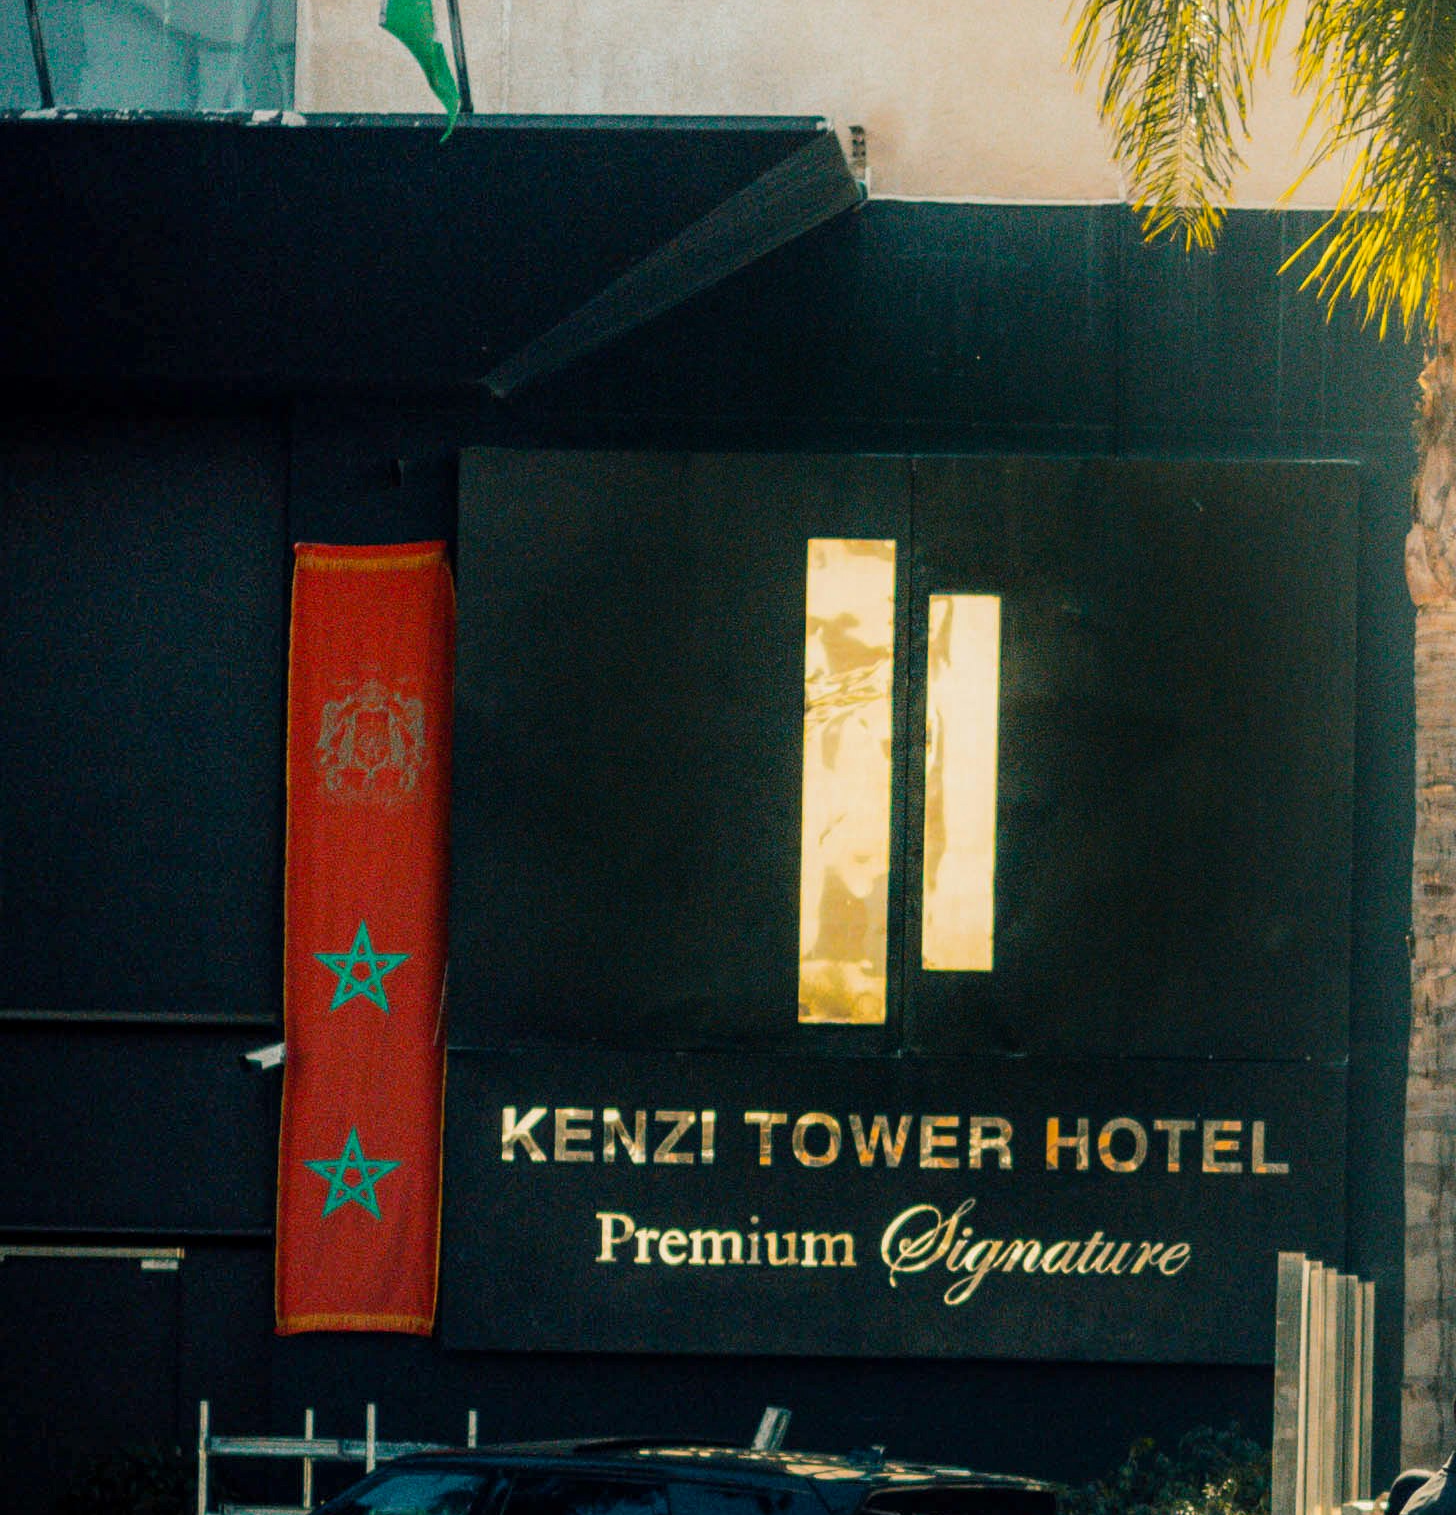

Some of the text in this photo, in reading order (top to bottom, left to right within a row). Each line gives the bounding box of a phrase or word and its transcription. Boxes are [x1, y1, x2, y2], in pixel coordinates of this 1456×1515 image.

[501, 1106, 1289, 1174] KENZI TOWER HOTEL
[595, 1199, 1191, 1306] Premium Signature
